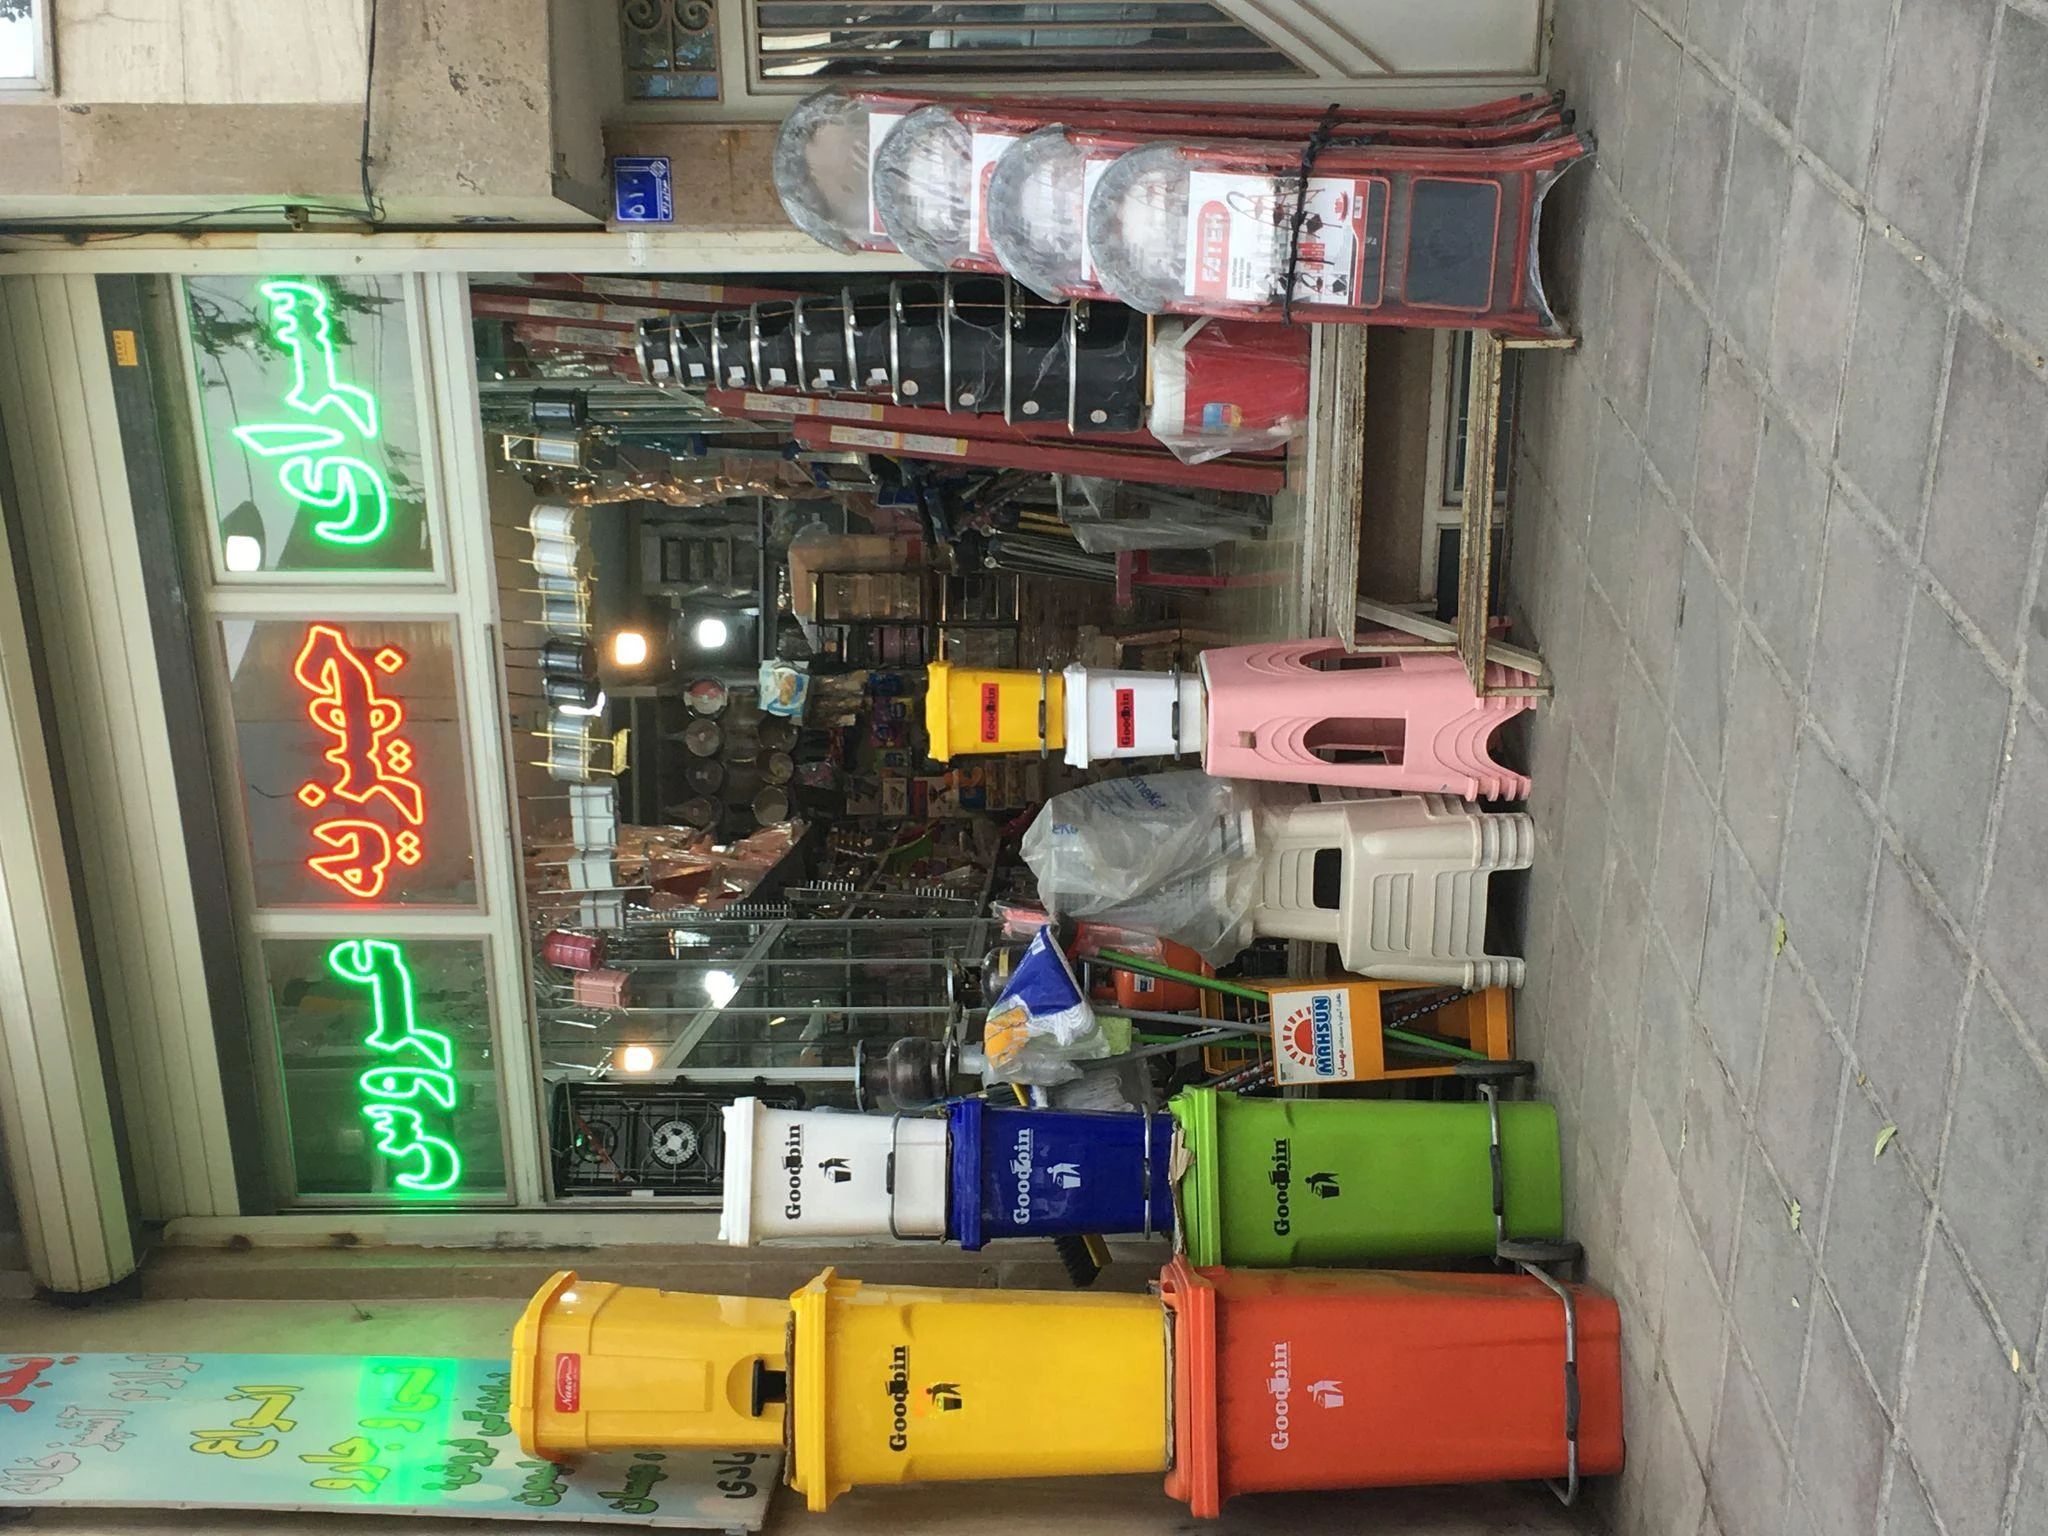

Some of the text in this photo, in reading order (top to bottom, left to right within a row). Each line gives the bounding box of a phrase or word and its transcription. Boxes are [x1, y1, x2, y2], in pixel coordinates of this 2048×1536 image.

[628, 178, 646, 215] ۵۱۰
[1201, 212, 1224, 283] FATEH
[232, 281, 461, 1191] سرای جهیزیه عروس
[1312, 996, 1334, 1075] MAHSUN
[782, 1124, 803, 1220] Goodbin
[1010, 1128, 1033, 1224] Goodbin
[1268, 1138, 1291, 1236] Goodbin
[189, 1385, 304, 1459] انواع
[358, 1418, 424, 1433] و
[885, 1344, 909, 1452] Goodbin
[1266, 1342, 1291, 1450] Goodbin
[298, 1437, 404, 1493] جارو
